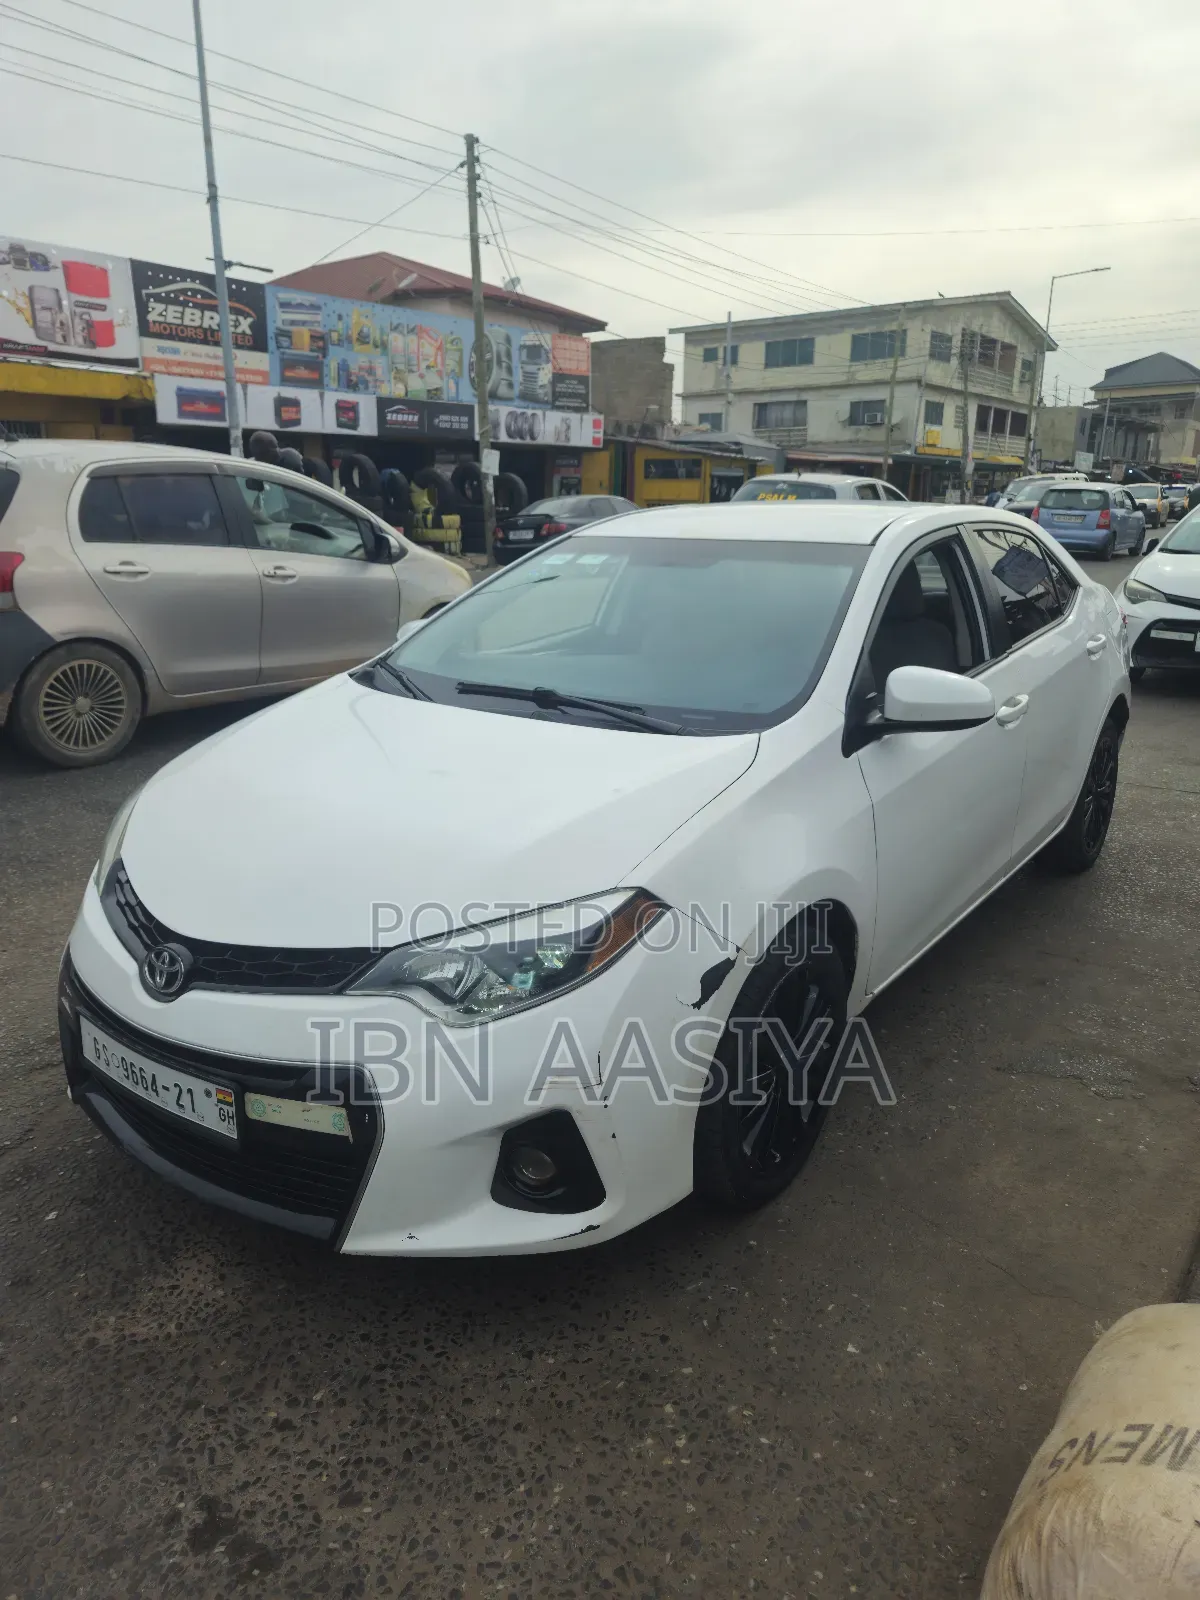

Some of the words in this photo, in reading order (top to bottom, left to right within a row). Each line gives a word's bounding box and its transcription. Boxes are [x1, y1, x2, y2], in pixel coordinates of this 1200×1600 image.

[149, 321, 204, 339] MOTORS
[93, 1036, 110, 1067] GS
[120, 1056, 197, 1113] 9664-21
[218, 1107, 235, 1125] GH
